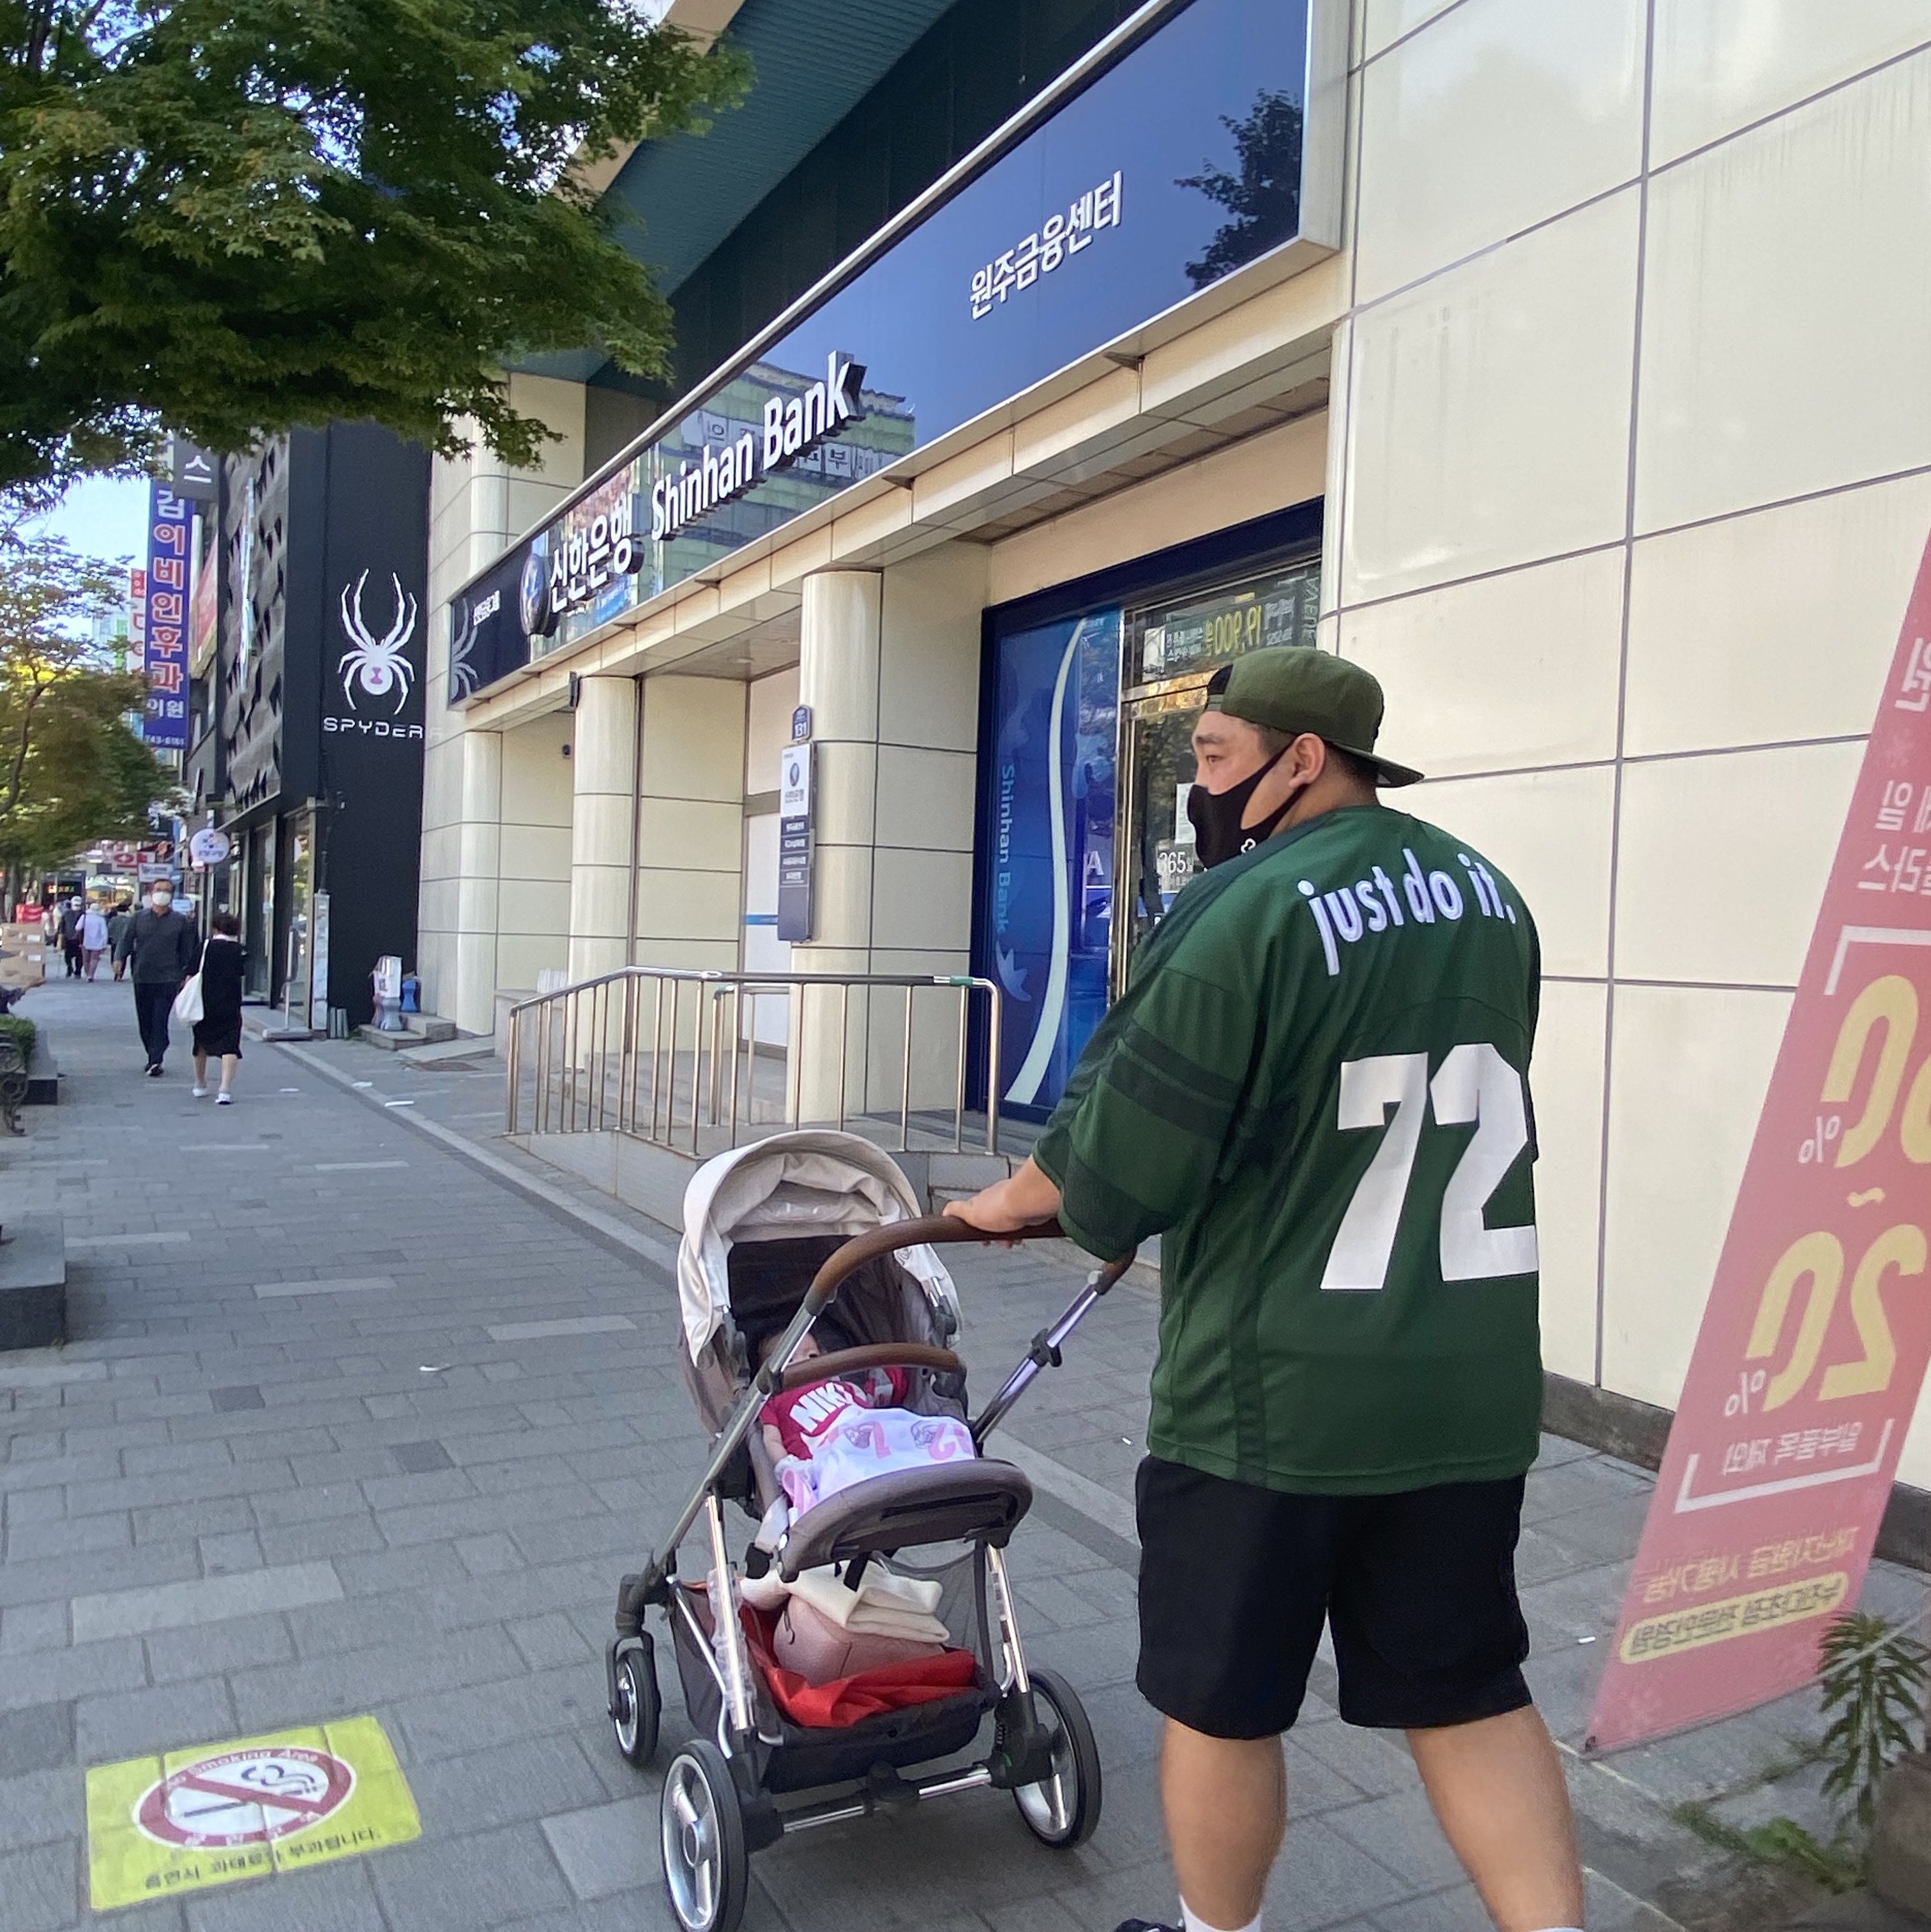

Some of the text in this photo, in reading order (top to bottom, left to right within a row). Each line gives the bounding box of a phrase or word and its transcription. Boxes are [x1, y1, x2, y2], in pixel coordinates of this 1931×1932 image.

[970, 170, 1123, 320] 원주금융센터
[652, 351, 851, 542] Shinhan Bank
[150, 489, 186, 695] 김이비인후과
[550, 494, 634, 613] 신한은행
[324, 717, 424, 740] SPYDER
[996, 764, 1015, 933] Shinhan Bank
[1297, 865, 1404, 977] just
[1402, 848, 1464, 924] do
[1320, 1042, 1540, 1290] 72
